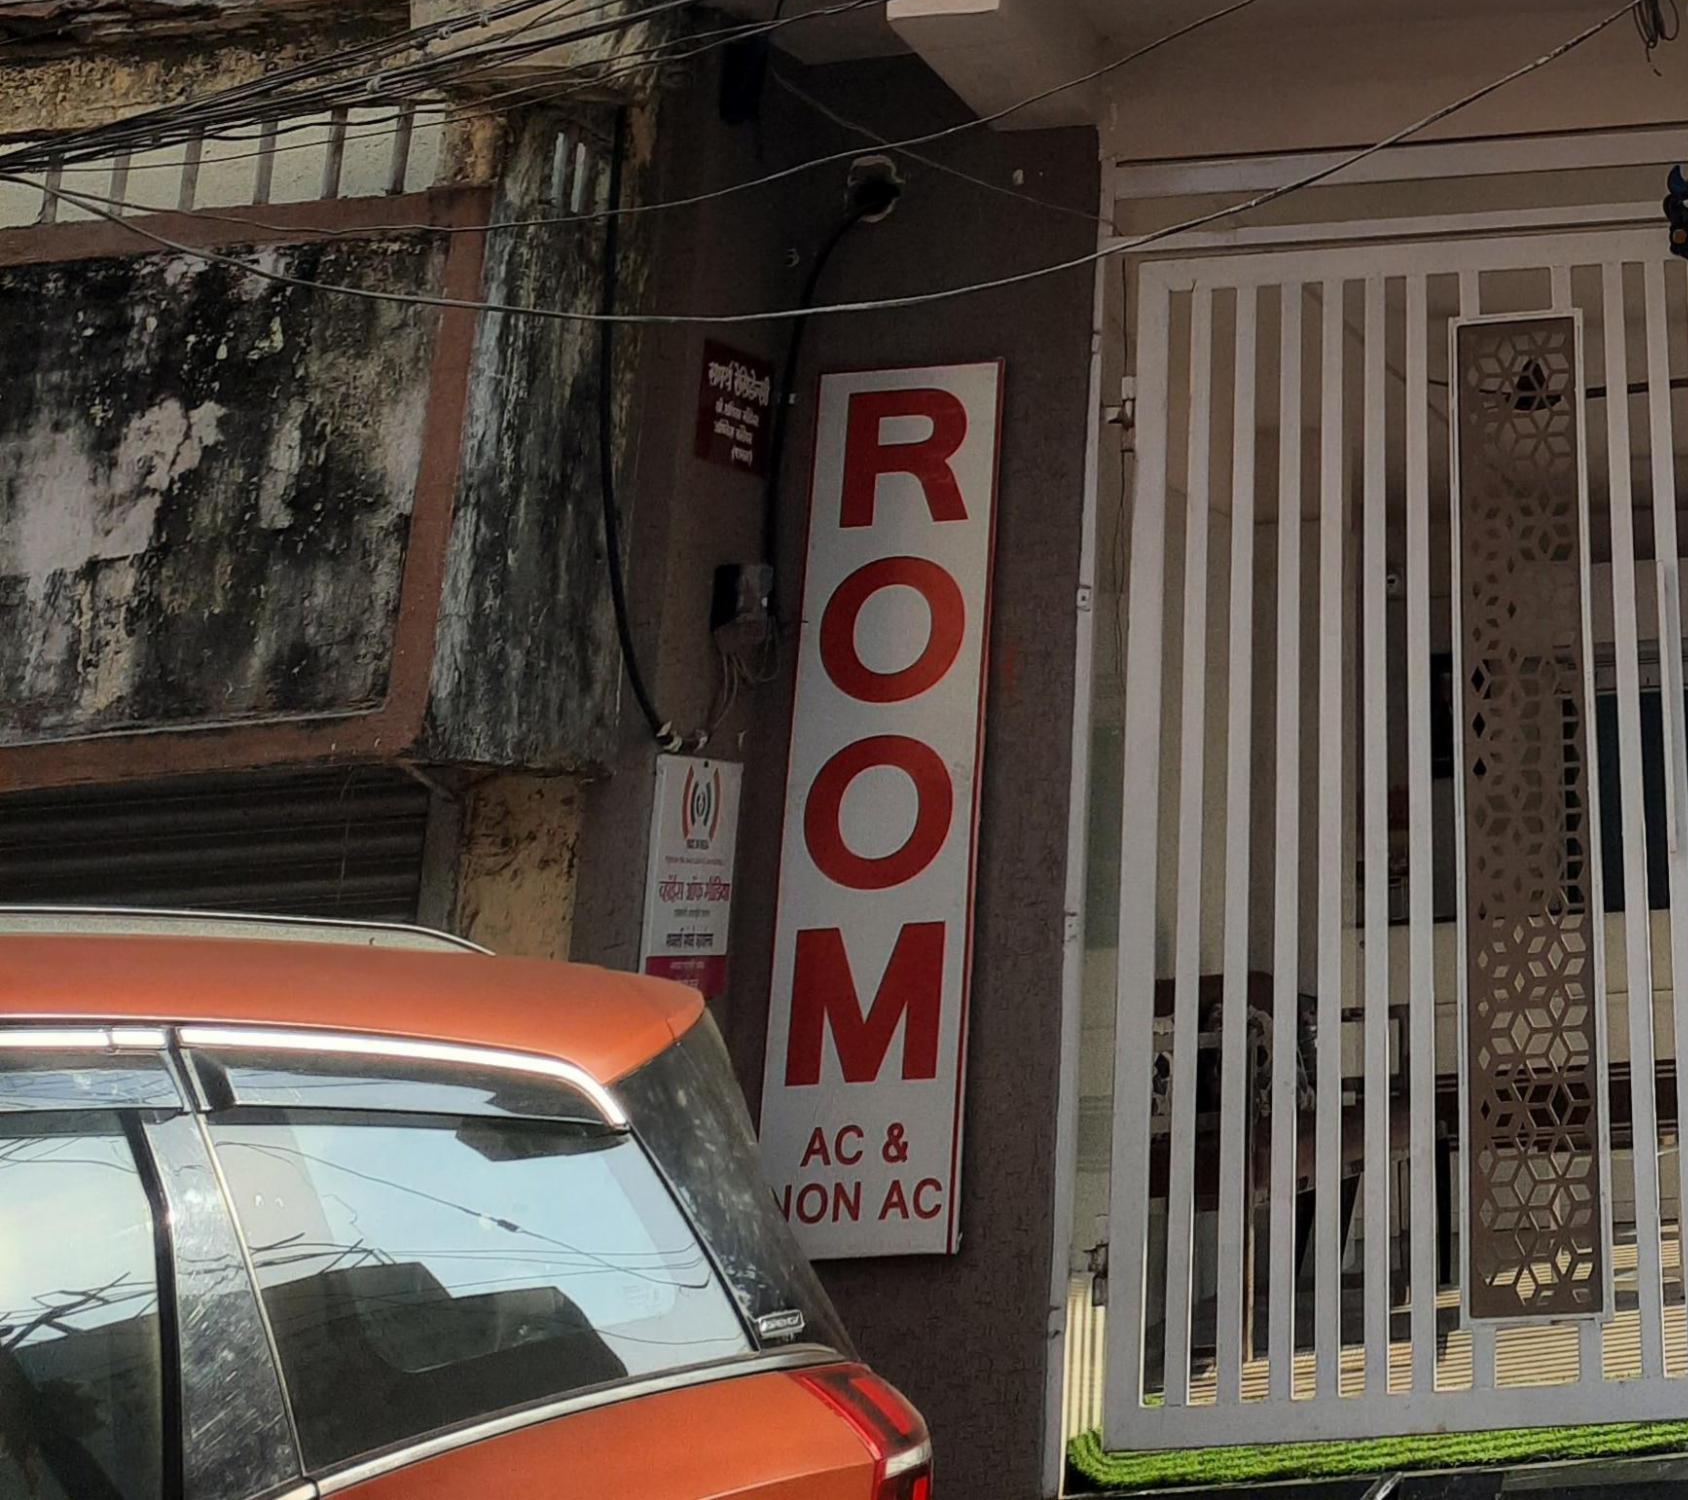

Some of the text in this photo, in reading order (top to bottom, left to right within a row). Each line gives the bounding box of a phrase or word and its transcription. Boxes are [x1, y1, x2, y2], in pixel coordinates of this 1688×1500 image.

[784, 388, 968, 1086] ROOM
[800, 1122, 908, 1167] AC &
[878, 1178, 943, 1220] AC
